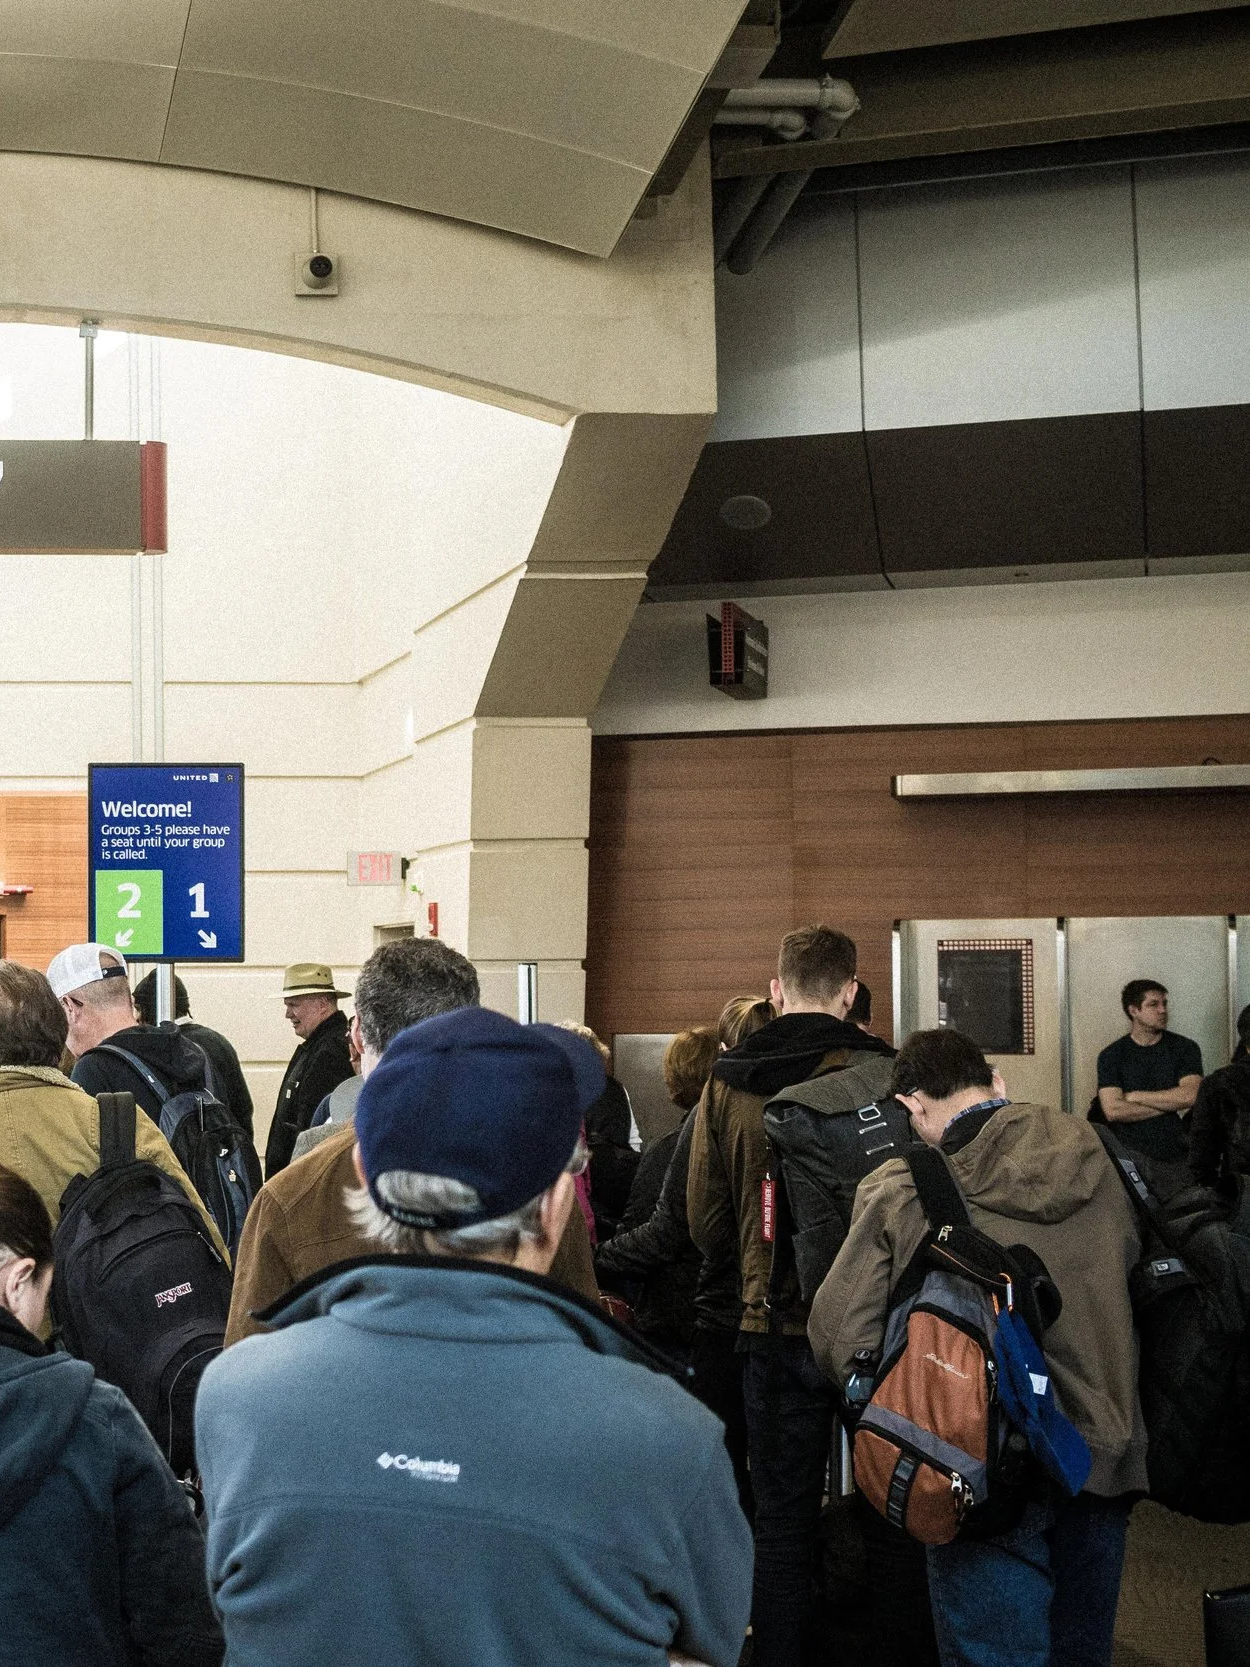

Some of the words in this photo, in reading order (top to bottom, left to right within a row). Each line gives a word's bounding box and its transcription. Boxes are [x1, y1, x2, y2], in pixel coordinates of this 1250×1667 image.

[101, 800, 192, 818] Welcome!
[101, 824, 141, 837] Groups
[143, 824, 163, 835] 3-5
[165, 824, 200, 837] please
[203, 823, 230, 835] have
[101, 838, 109, 847] a
[111, 837, 134, 847] seat
[136, 836, 161, 847] until
[164, 838, 190, 849] your
[192, 838, 226, 849] group
[101, 848, 111, 860] is
[113, 848, 148, 860] called.
[357, 854, 393, 882] EXIT
[117, 882, 142, 919] 2
[188, 882, 210, 918] 1
[392, 1453, 461, 1476] Columbia
